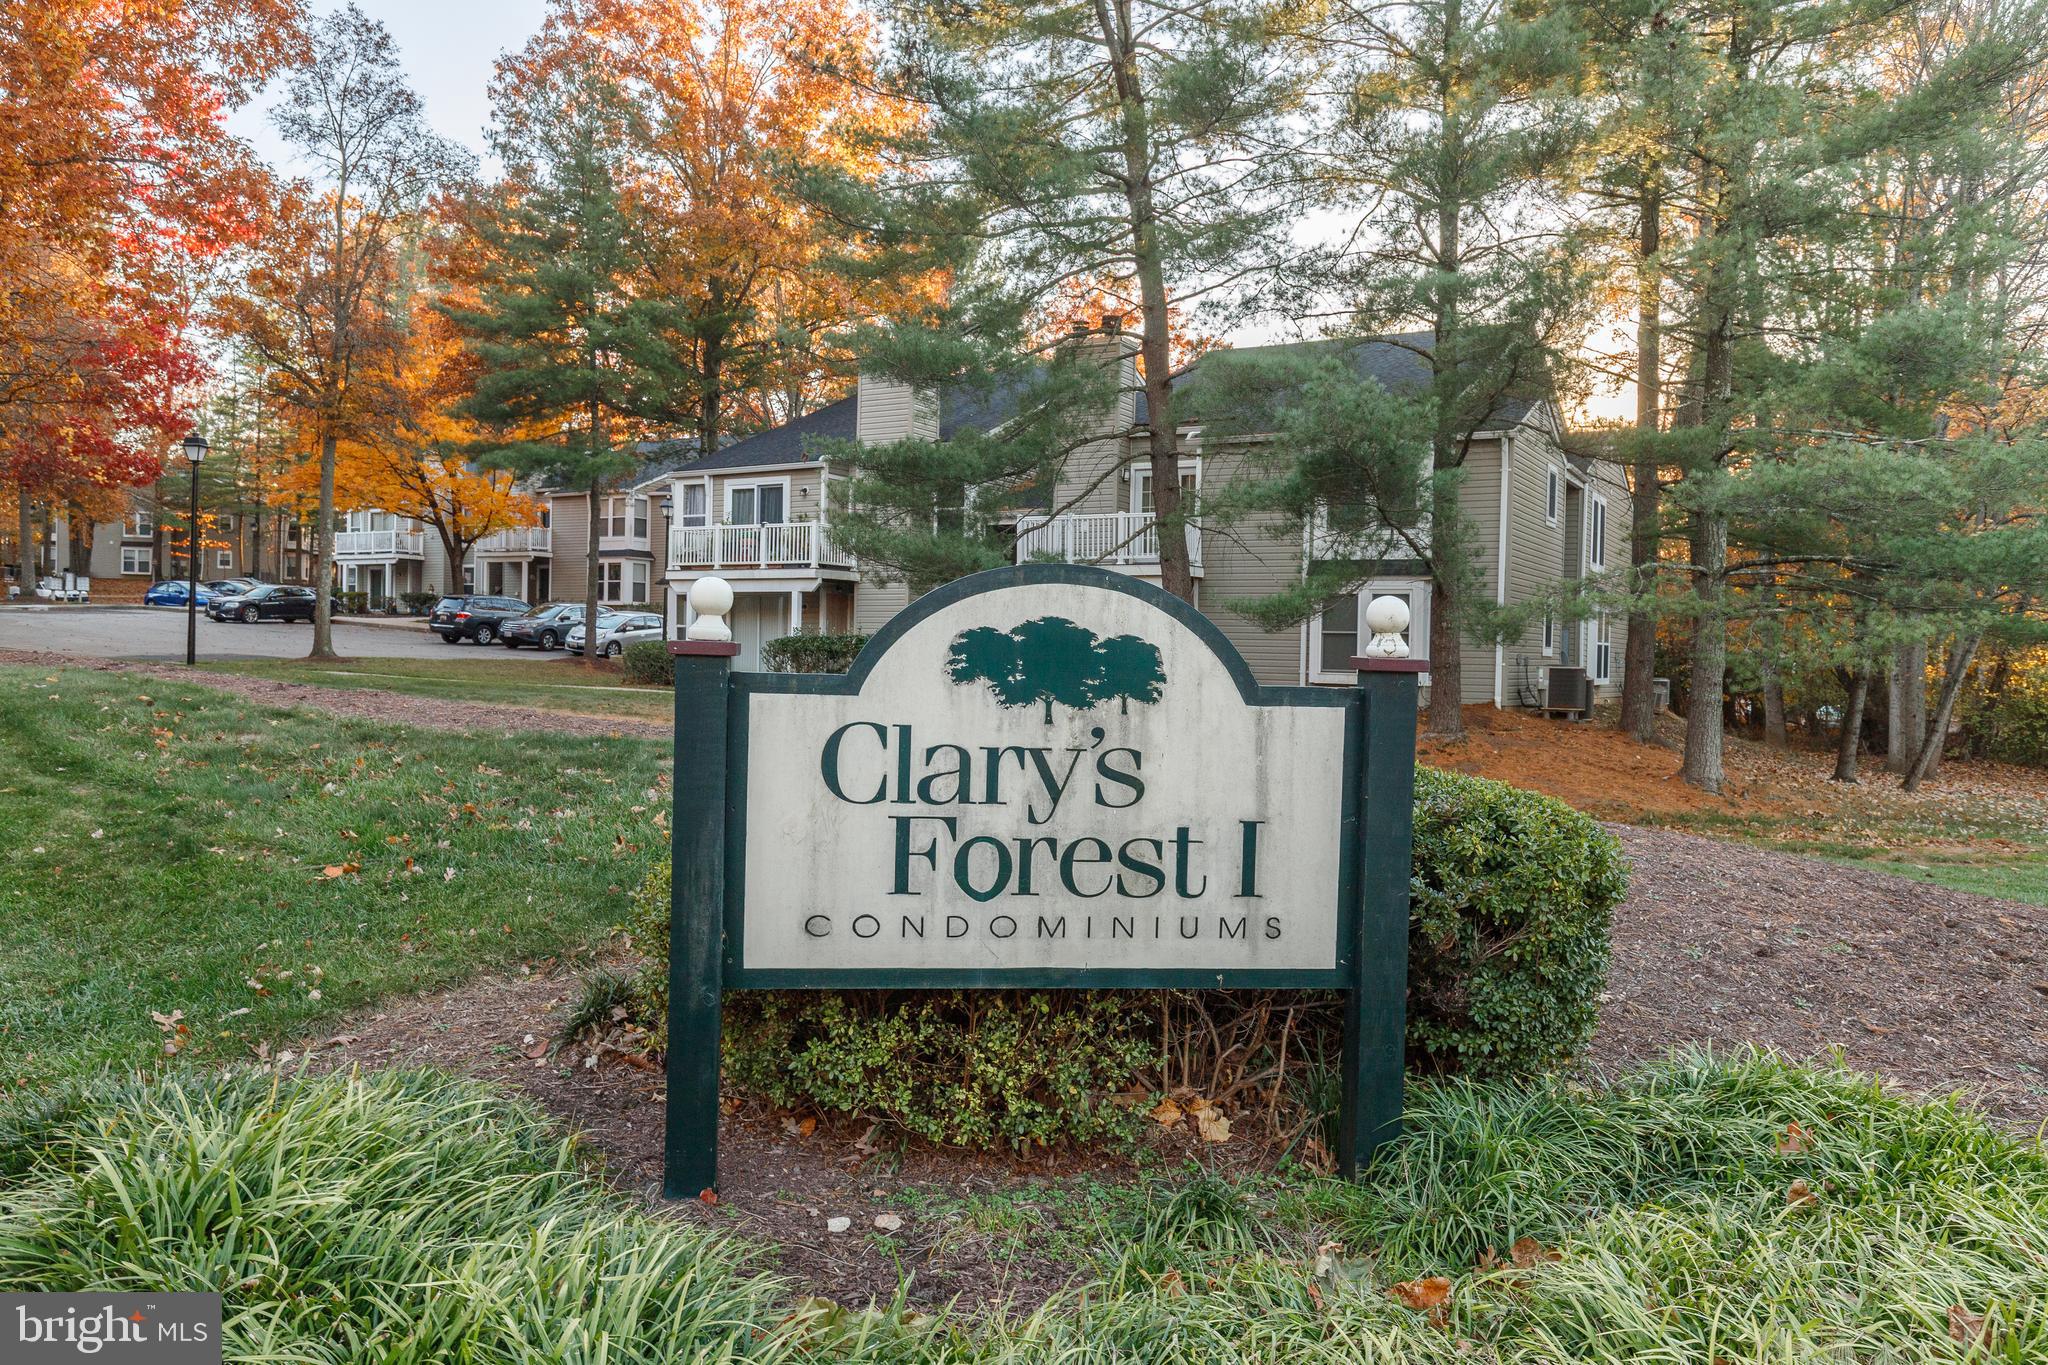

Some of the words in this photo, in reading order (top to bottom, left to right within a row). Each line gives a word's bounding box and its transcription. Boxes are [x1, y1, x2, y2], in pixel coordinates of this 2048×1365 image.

[820, 721, 1145, 824] Clary's
[887, 815, 1207, 902] Forest
[1233, 820, 1266, 898] I
[804, 914, 1282, 939] CONDOMINIUMS
